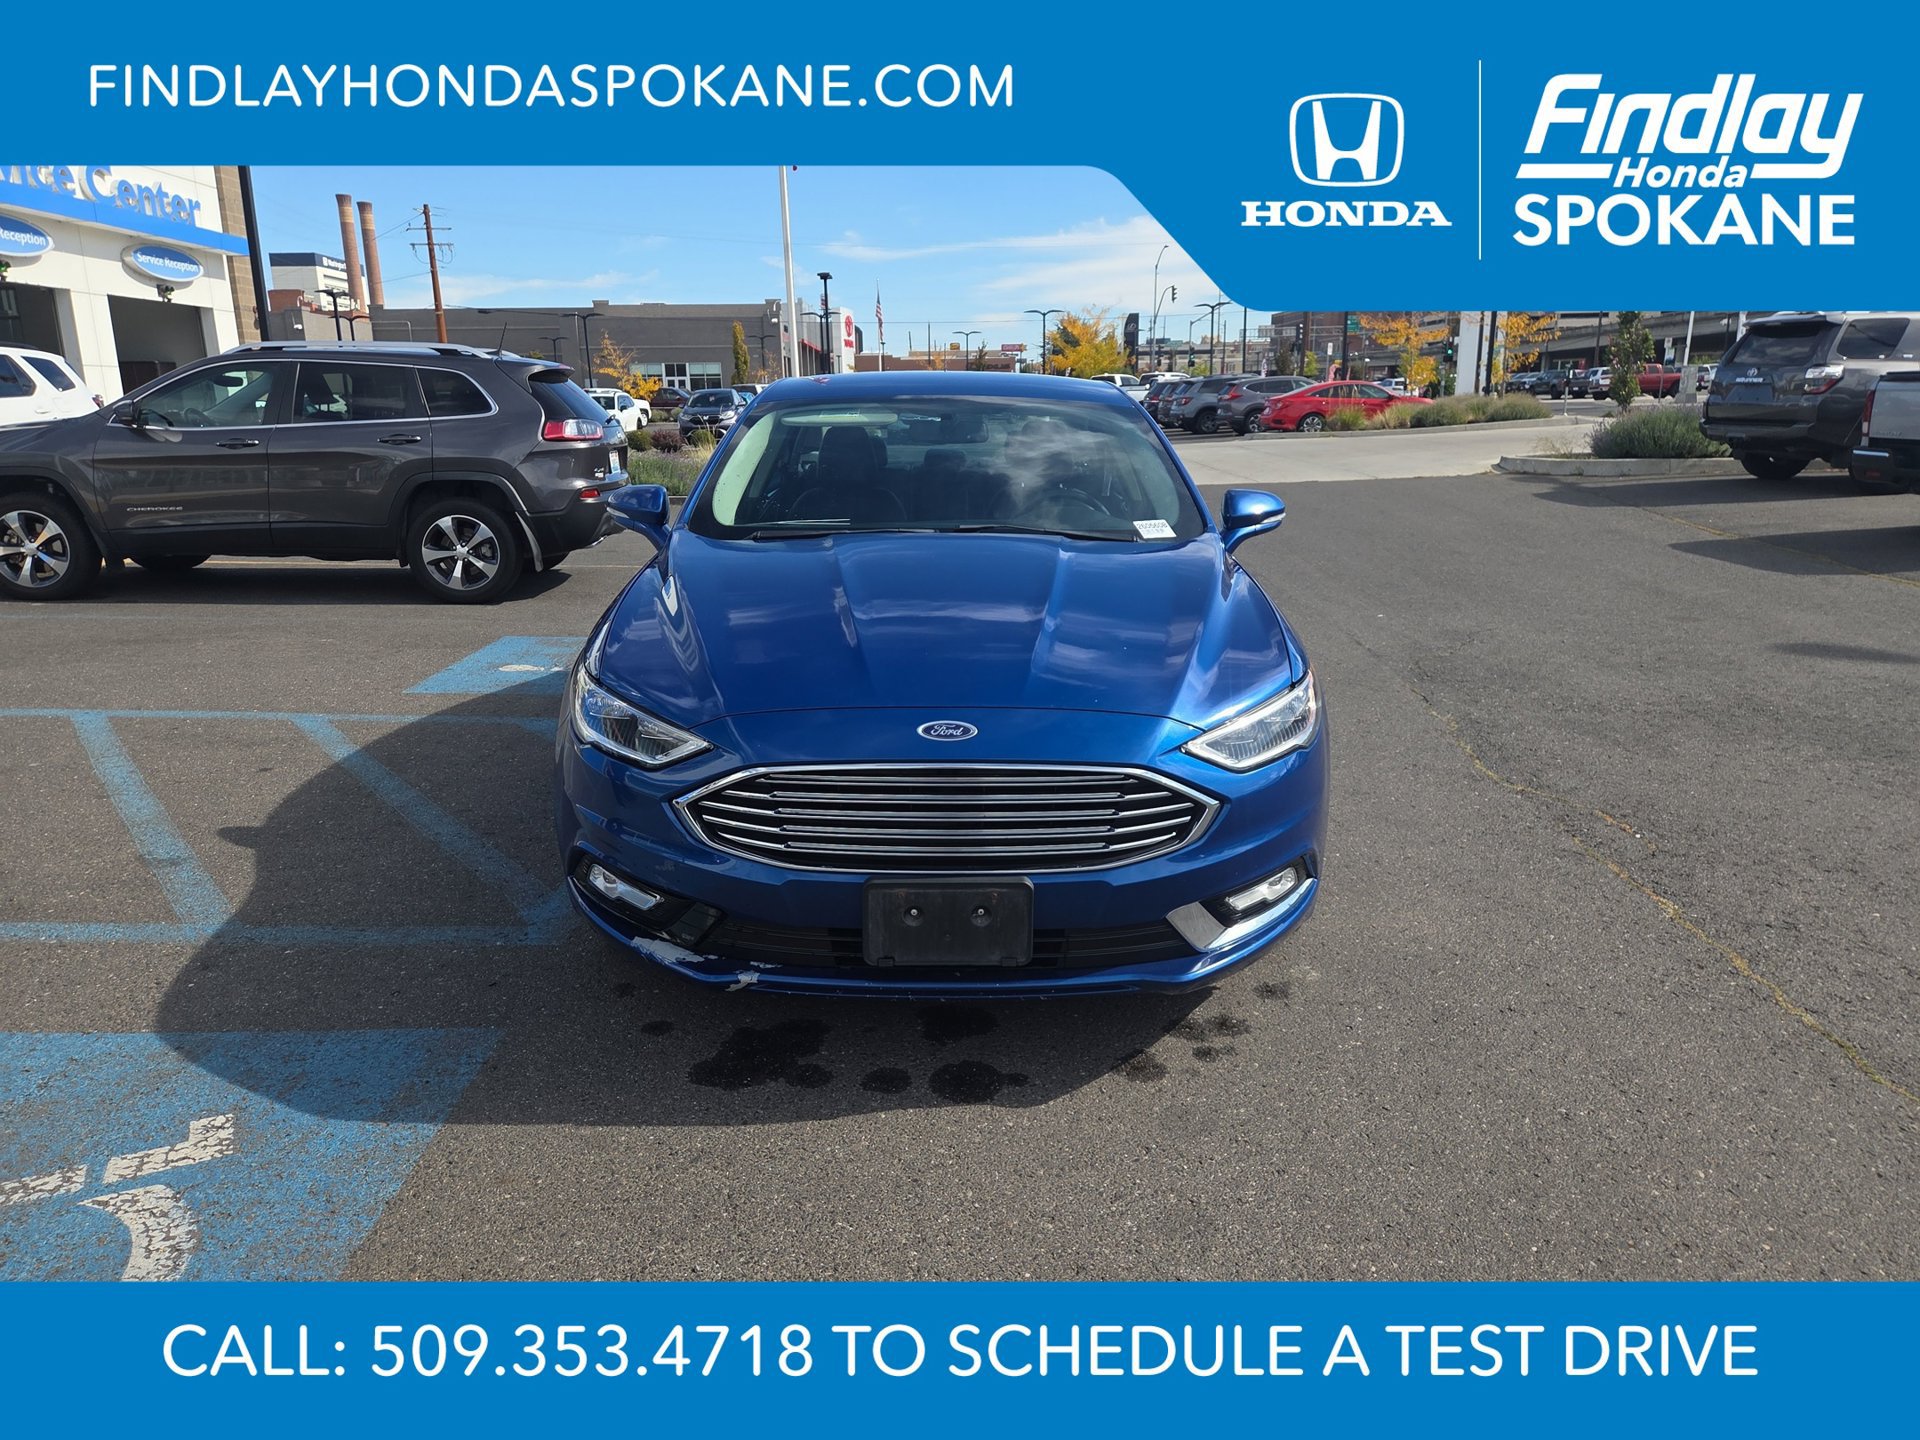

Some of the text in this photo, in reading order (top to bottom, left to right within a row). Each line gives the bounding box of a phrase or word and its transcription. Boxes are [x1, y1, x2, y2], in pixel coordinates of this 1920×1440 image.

[80, 166, 201, 226] Center
[136, 251, 199, 272] Service Reception
[930, 723, 964, 736] Ford
